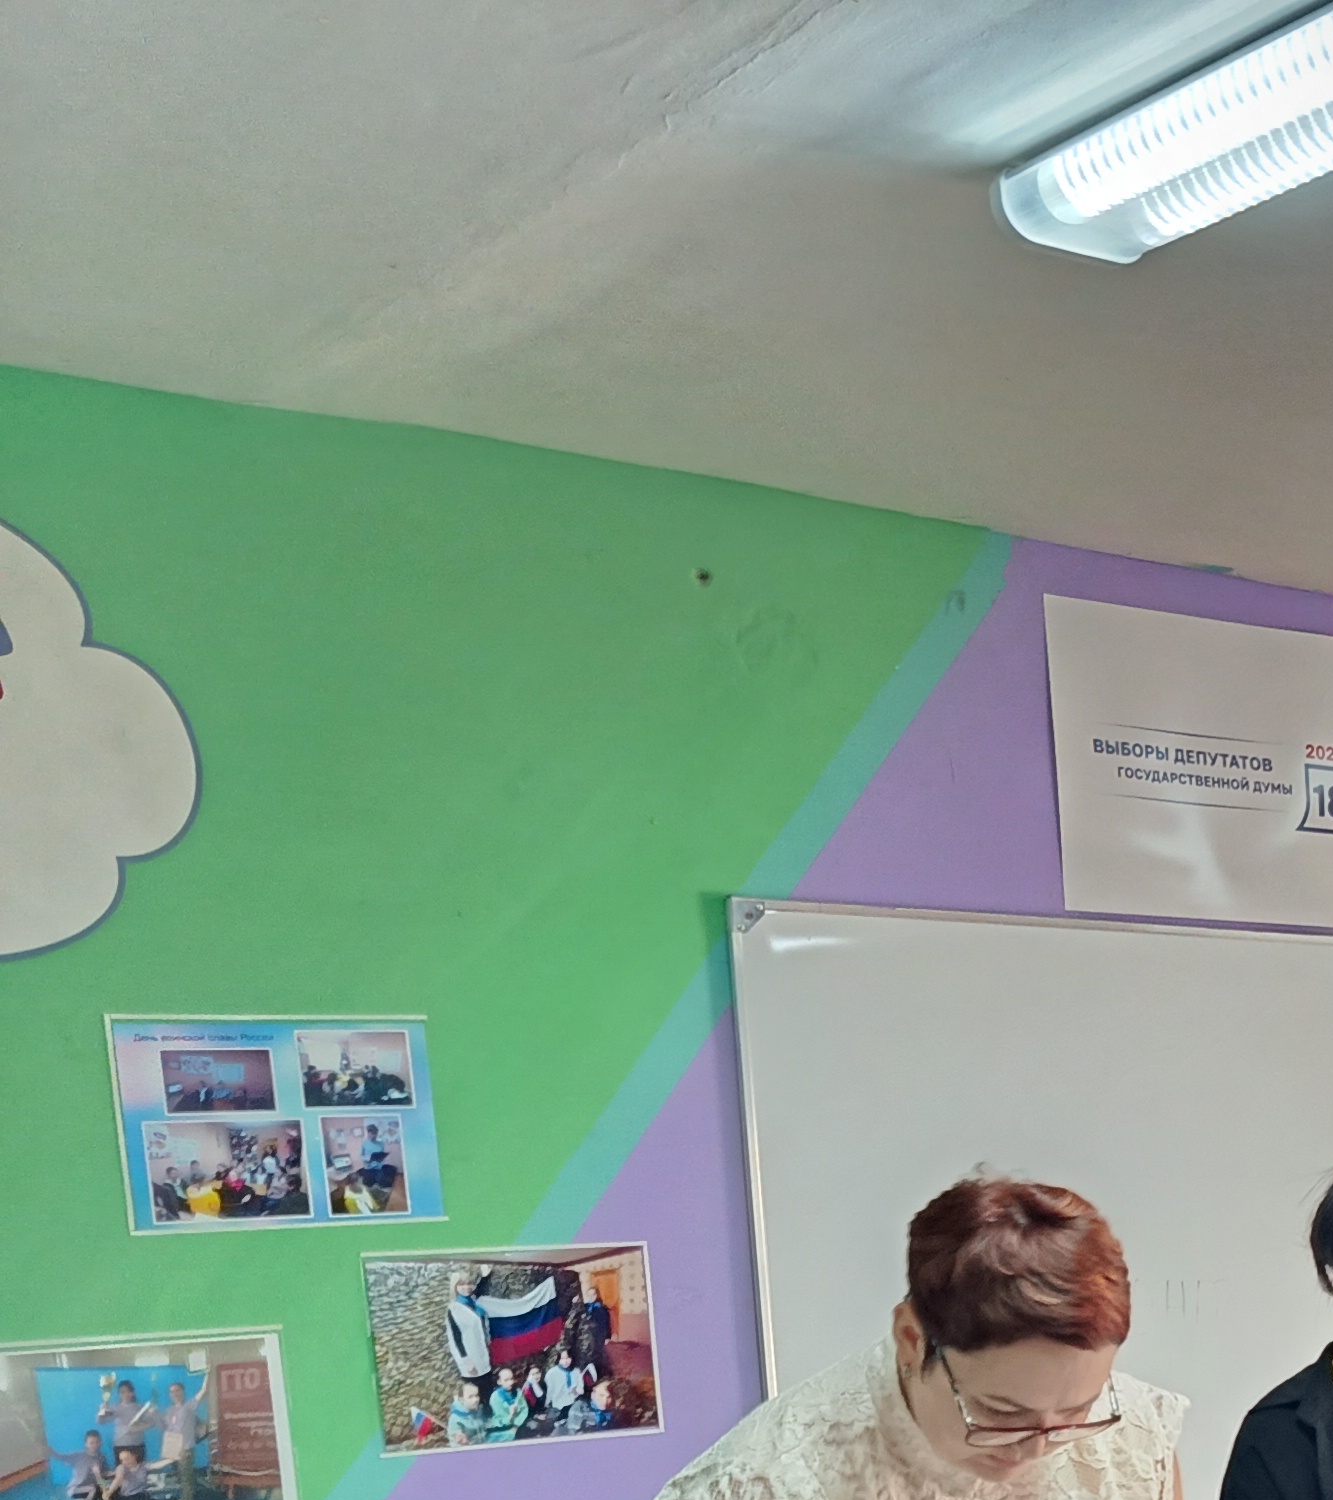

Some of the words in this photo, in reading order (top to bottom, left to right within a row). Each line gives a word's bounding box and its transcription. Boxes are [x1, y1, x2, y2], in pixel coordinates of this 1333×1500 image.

[1092, 738, 1169, 761] ВЫБОРЫ
[1173, 749, 1273, 772] ДЕПУТАТОВ
[1117, 766, 1250, 791] ГОСУДАРСТВЕННОЙ
[1252, 781, 1293, 795] ДУМЫ
[220, 1368, 260, 1392] ГТО
